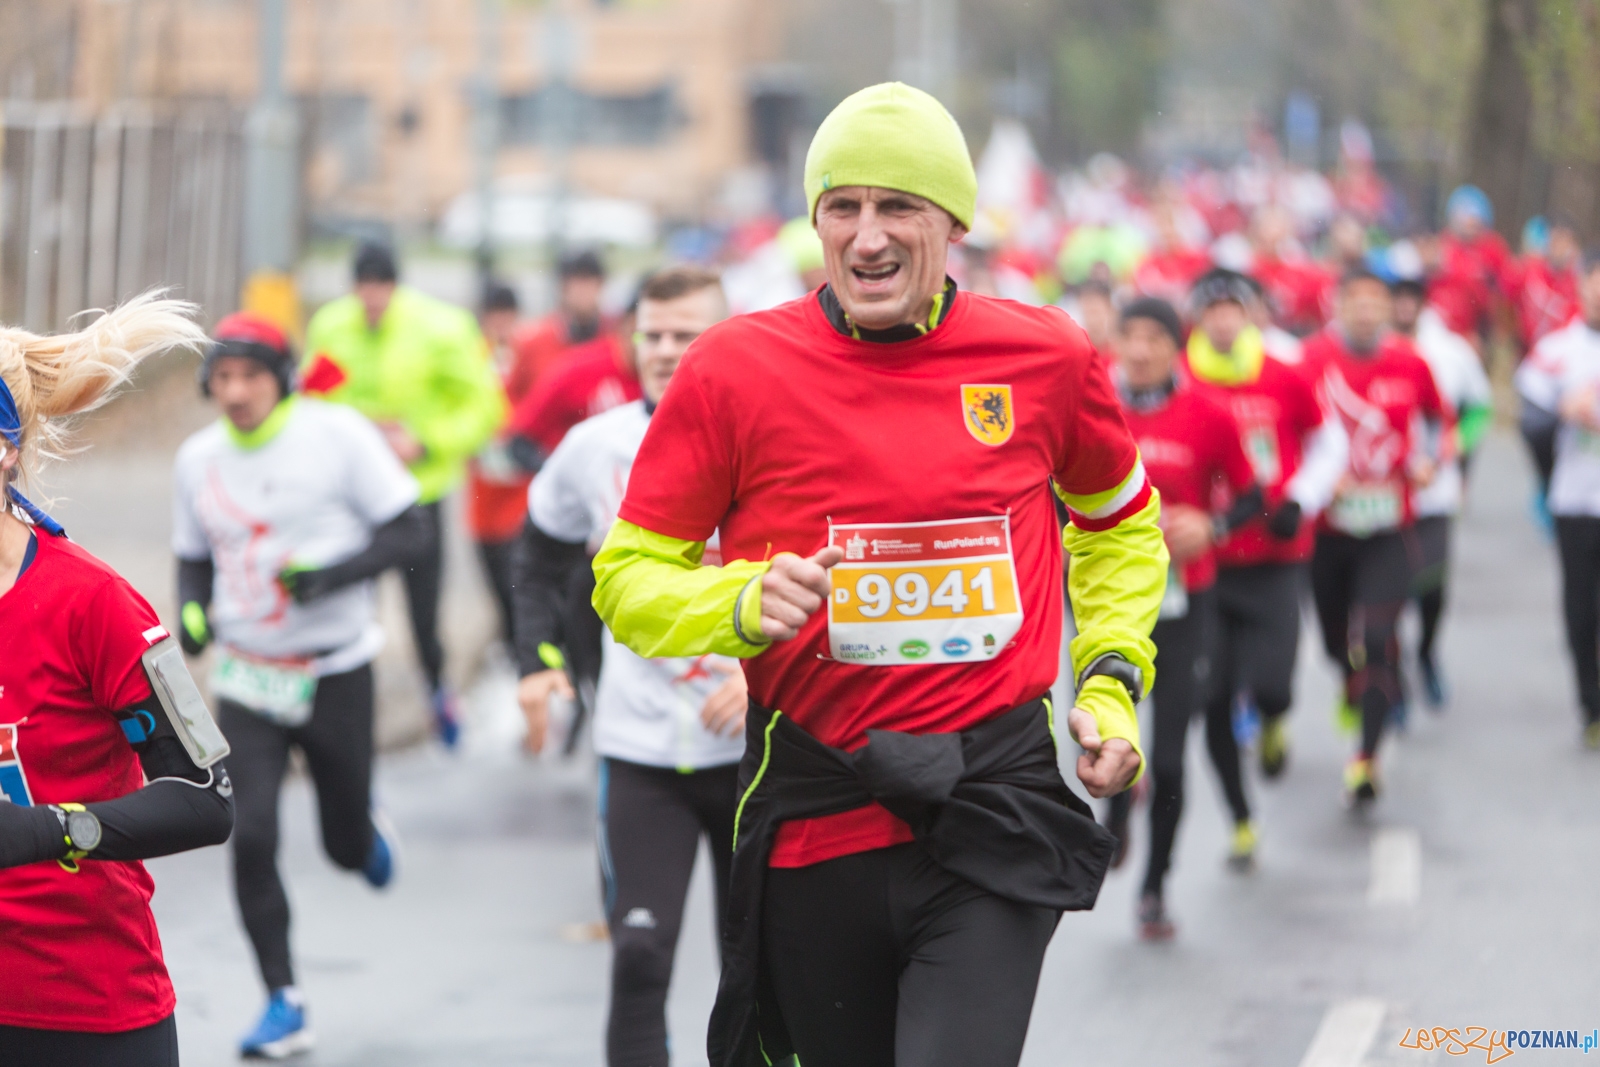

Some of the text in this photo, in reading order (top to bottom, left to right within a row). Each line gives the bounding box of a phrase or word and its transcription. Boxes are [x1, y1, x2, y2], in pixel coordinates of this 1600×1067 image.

[933, 536, 1000, 550] RunPoland.org
[835, 566, 996, 619] D 9941
[840, 643, 870, 651] GRUPA
